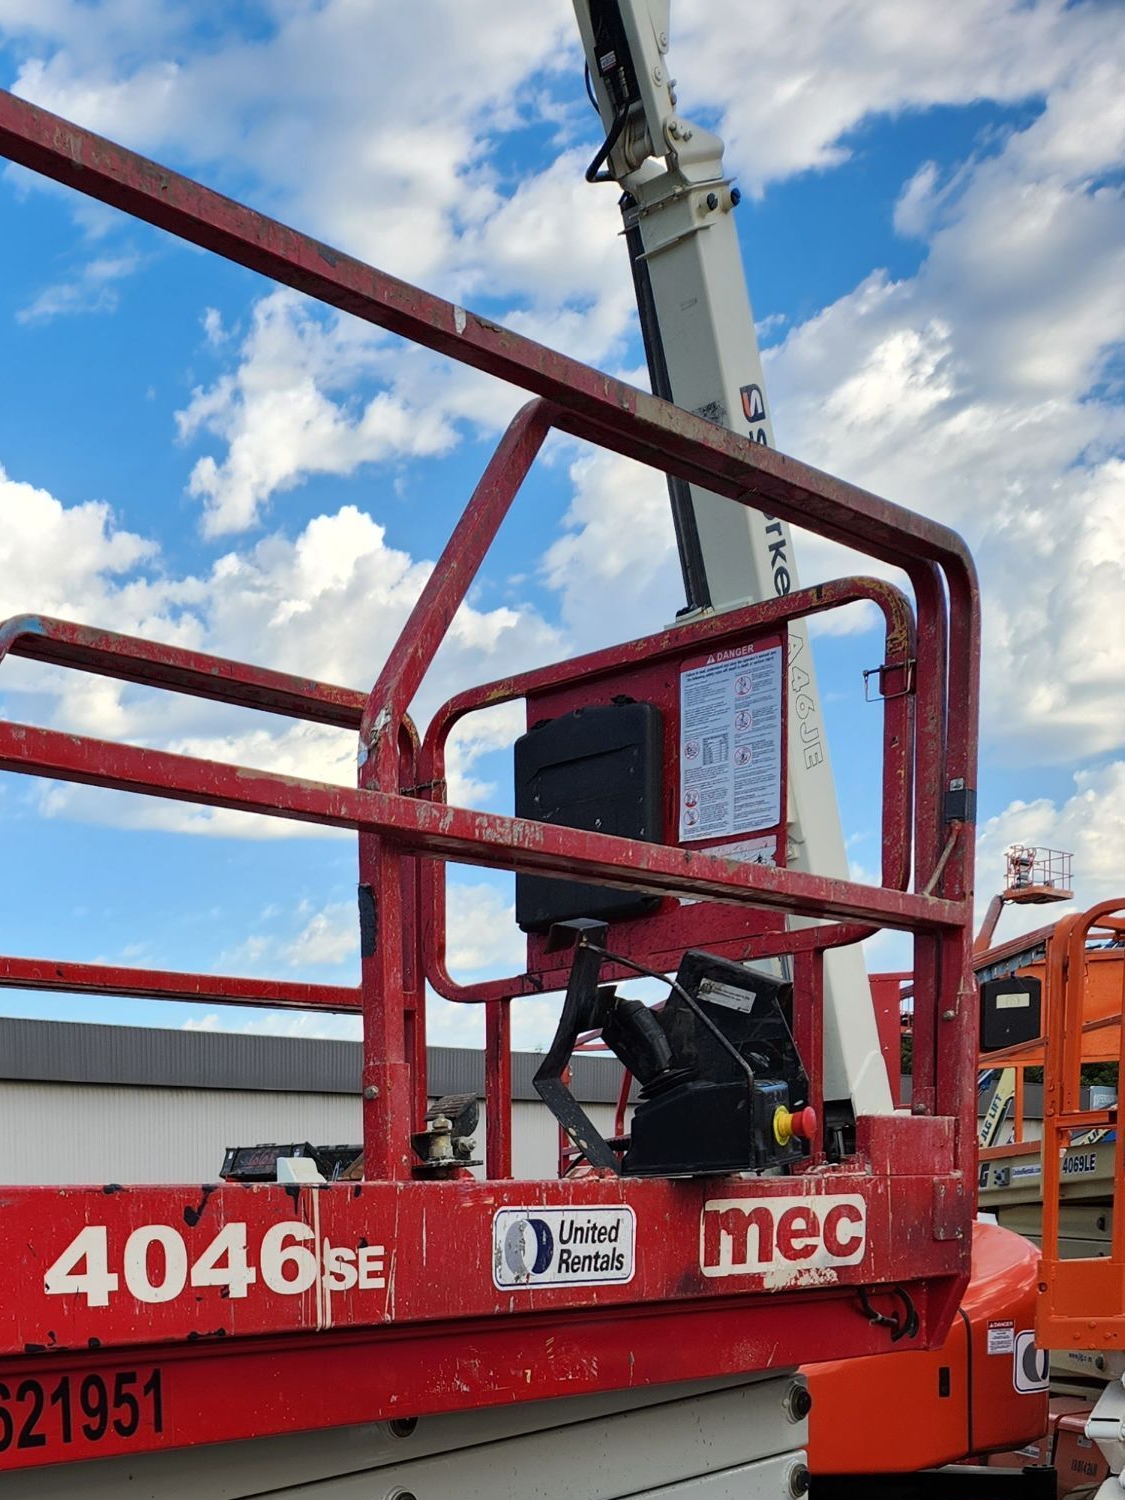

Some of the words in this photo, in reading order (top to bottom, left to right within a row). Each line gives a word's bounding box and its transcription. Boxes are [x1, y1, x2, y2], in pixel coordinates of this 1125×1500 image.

[716, 644, 754, 661] DANGER
[980, 1122, 992, 1141] JLG
[991, 1094, 1002, 1120] LIFT
[1062, 1153, 1096, 1174] 4069LE
[559, 1218, 621, 1245] United
[703, 1203, 863, 1268] mec
[557, 1247, 625, 1274] Rentals
